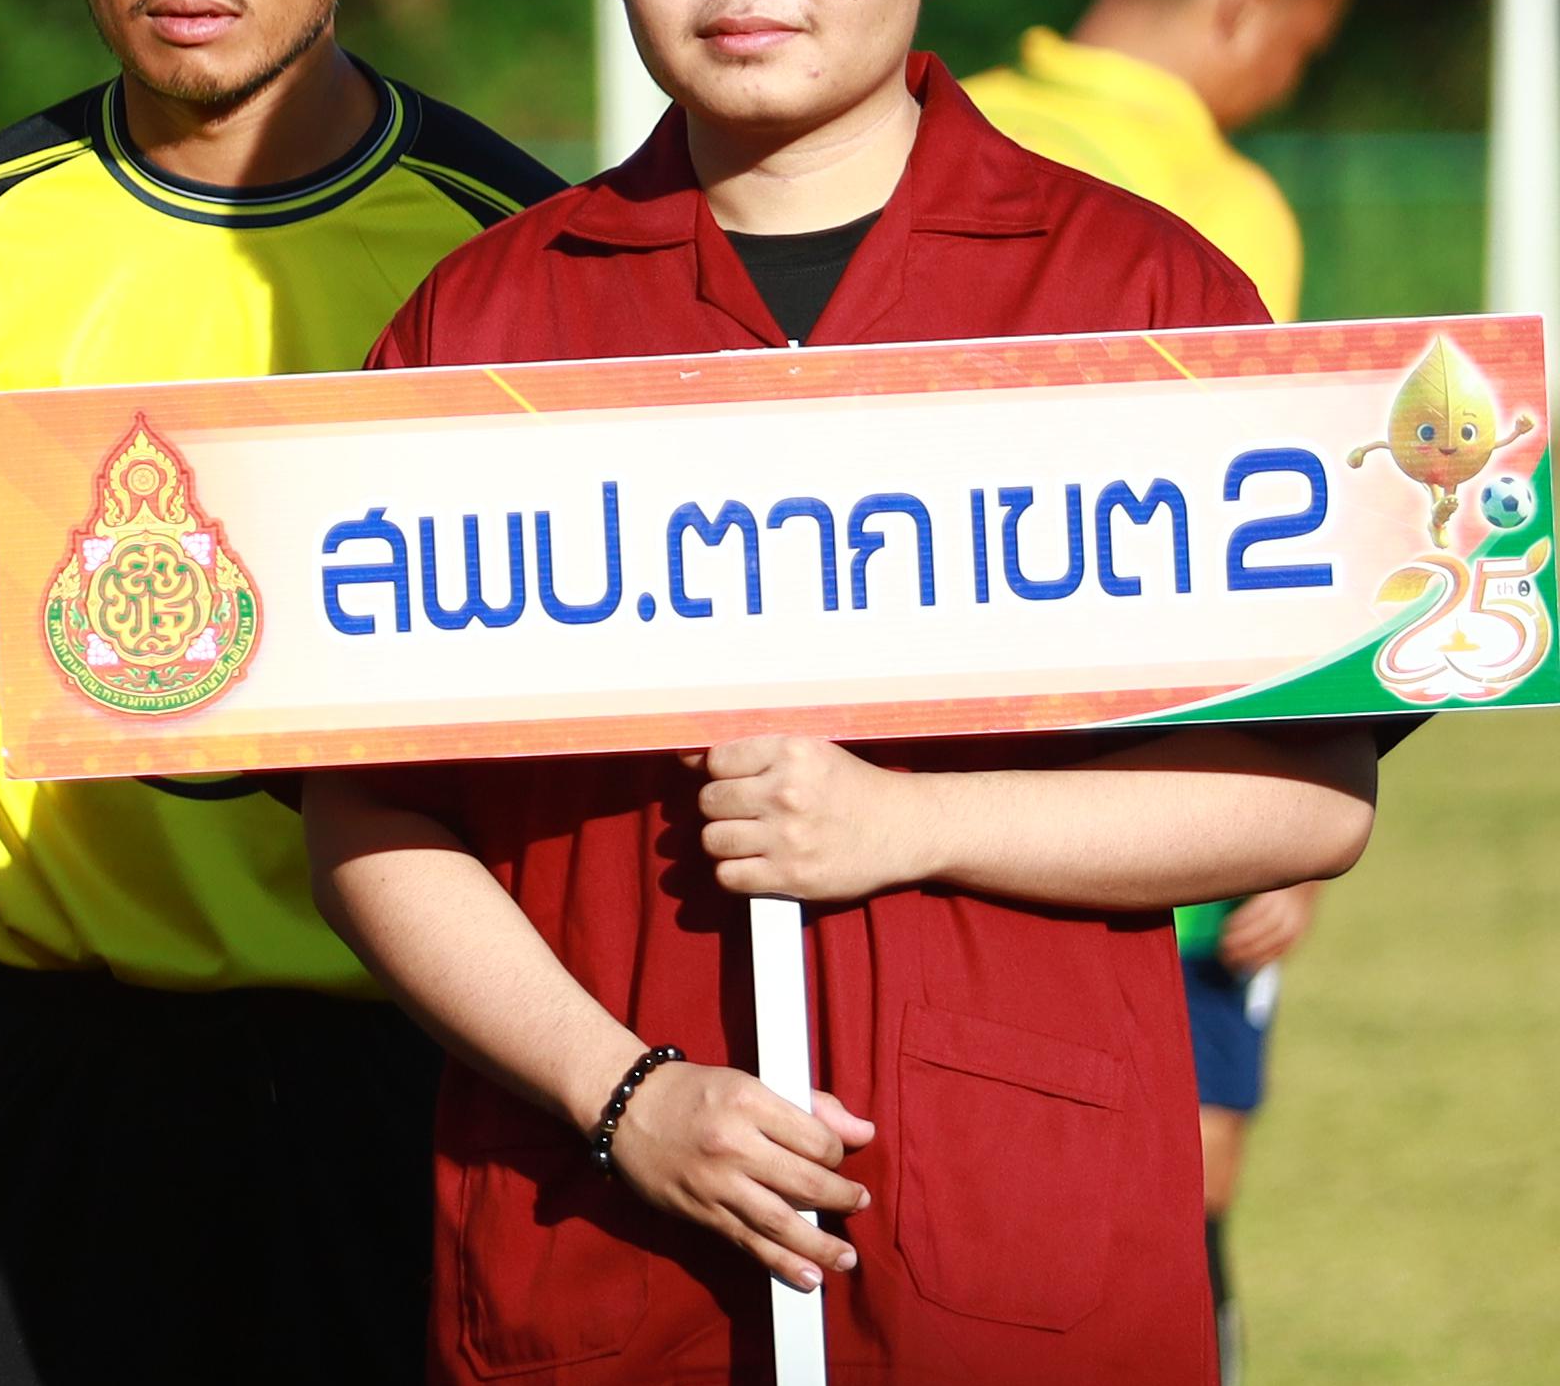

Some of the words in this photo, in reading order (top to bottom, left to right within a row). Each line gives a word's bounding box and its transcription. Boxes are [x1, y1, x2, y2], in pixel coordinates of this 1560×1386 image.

[321, 481, 936, 636] สพป.ตาก
[969, 477, 1192, 605] เขต
[1221, 446, 1334, 593] 2
